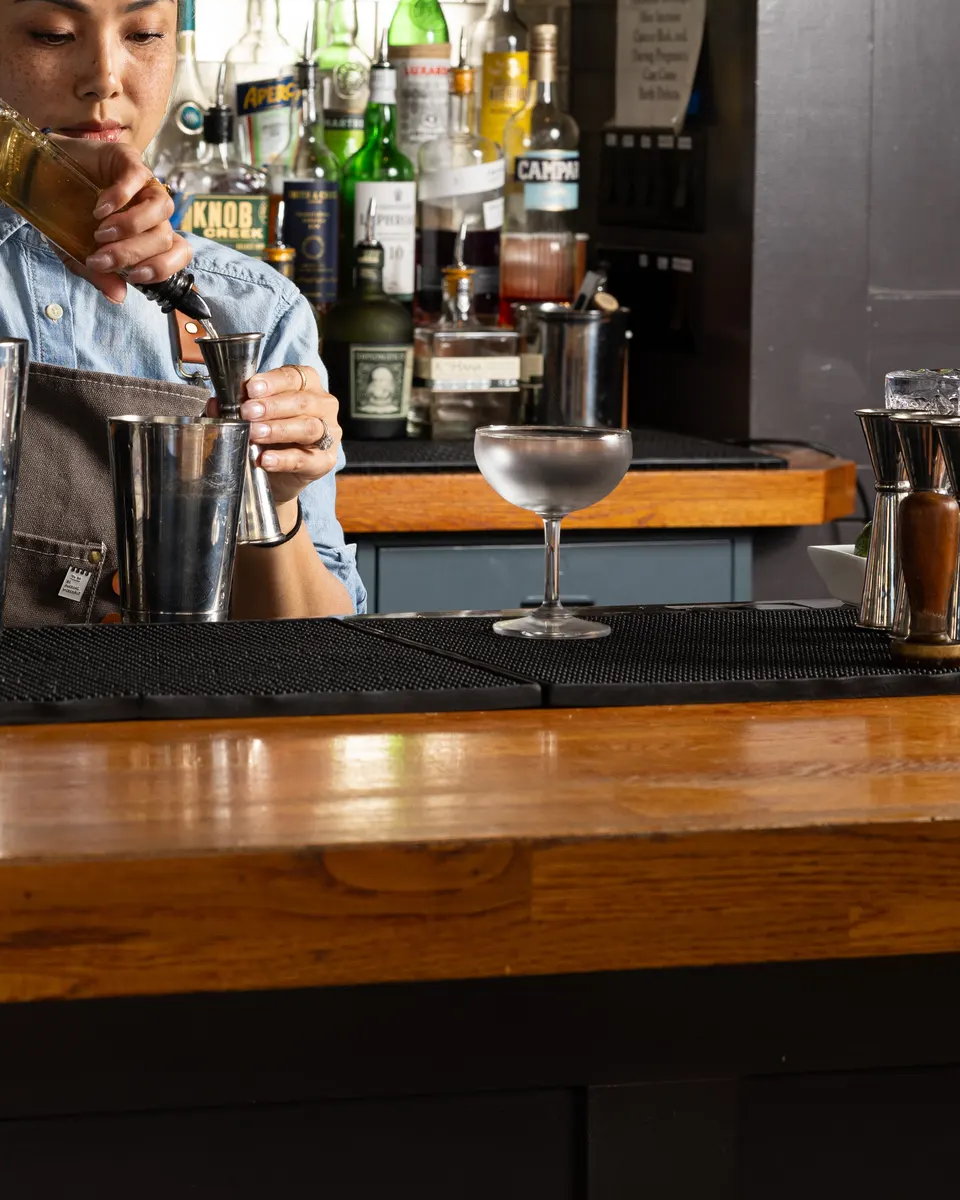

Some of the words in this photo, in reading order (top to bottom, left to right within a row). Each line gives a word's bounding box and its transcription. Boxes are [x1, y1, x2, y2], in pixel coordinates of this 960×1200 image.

[404, 65, 450, 77] LUXARD
[243, 81, 302, 110] APERO
[193, 200, 253, 228] KNOB
[203, 227, 264, 239] CREEK
